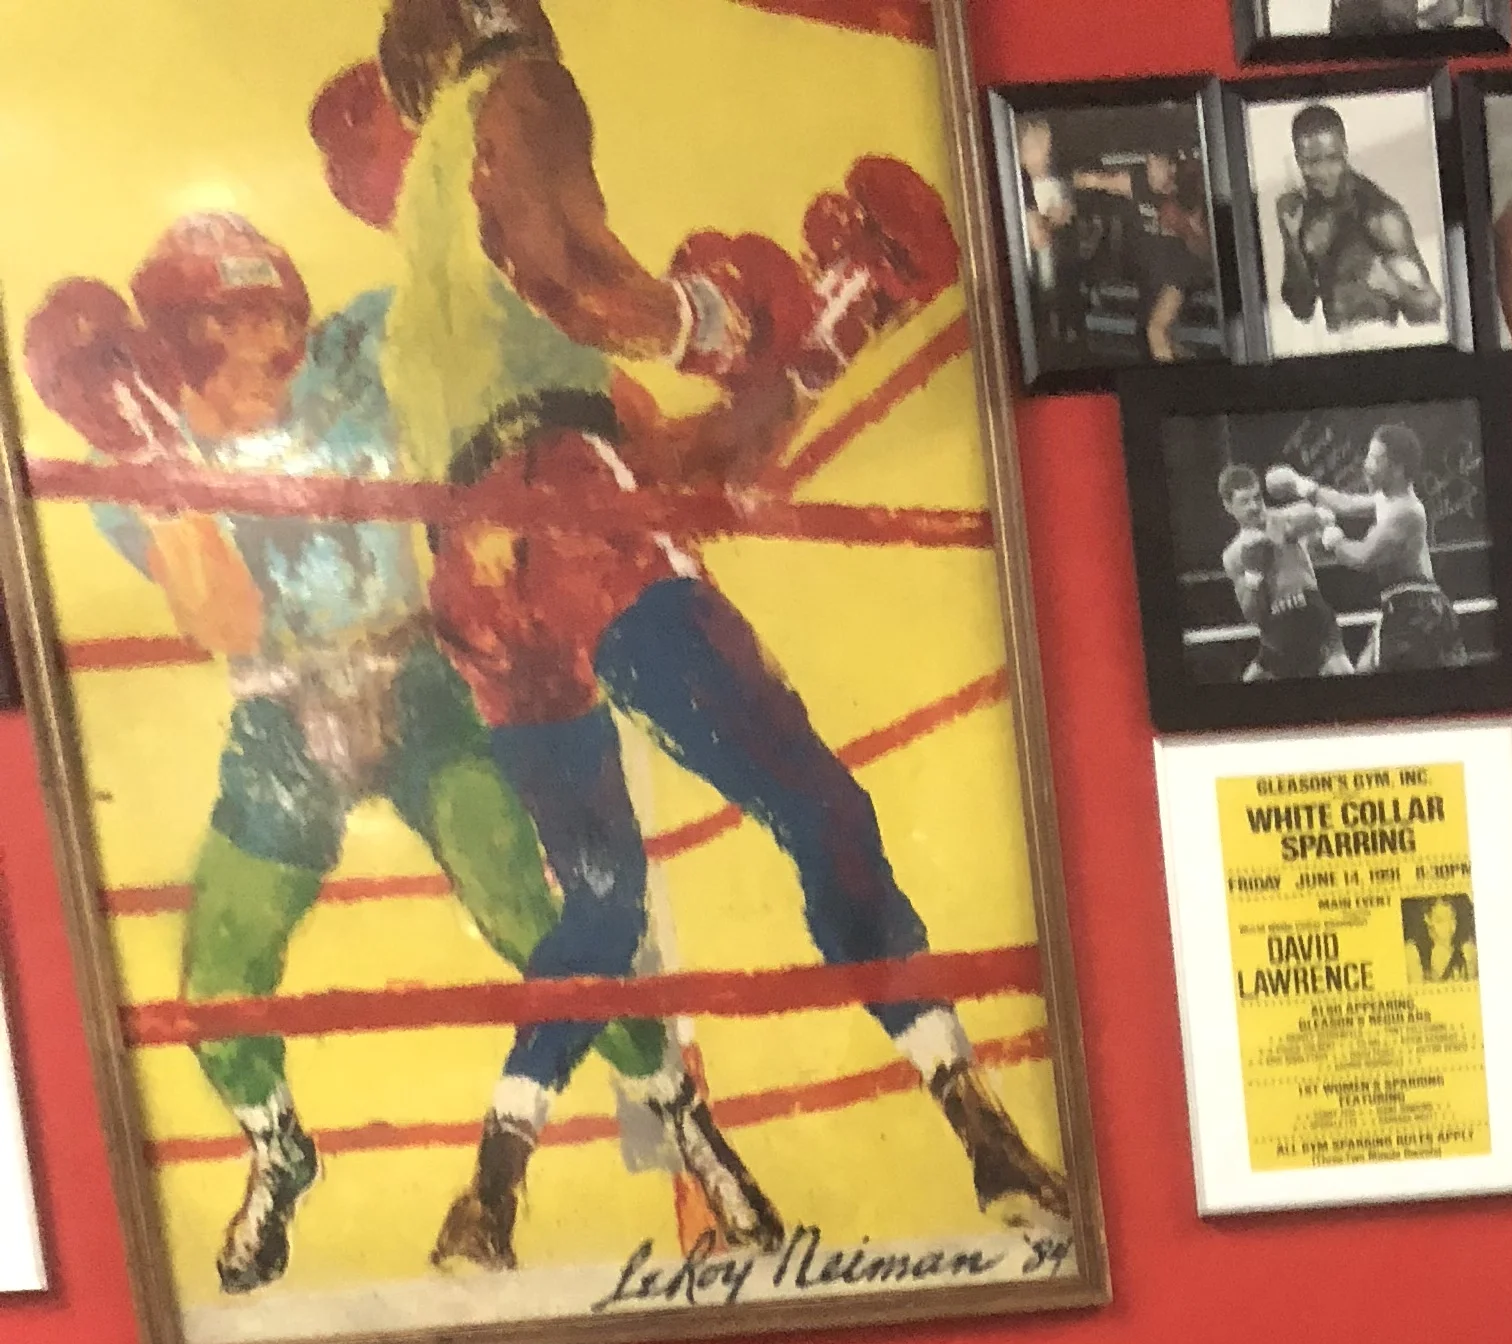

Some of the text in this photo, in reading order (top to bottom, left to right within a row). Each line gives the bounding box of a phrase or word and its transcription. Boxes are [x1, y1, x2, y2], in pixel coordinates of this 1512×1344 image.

[1256, 771, 1349, 797] GLEASON'S
[1246, 795, 1446, 834] WHITE COLLAR
[1280, 826, 1416, 861] SPARRING
[1295, 870, 1338, 890] JUNE
[1355, 895, 1392, 909] EVENT
[1267, 932, 1340, 965] DAVID
[1237, 960, 1376, 999] LAWRENCE
[1302, 1140, 1329, 1154] GYM
[1332, 1134, 1393, 1151] SPARRING
[1437, 1129, 1475, 1145] APPLY
[591, 1229, 754, 1314] LeRoy
[773, 1223, 1006, 1289] Neiman
